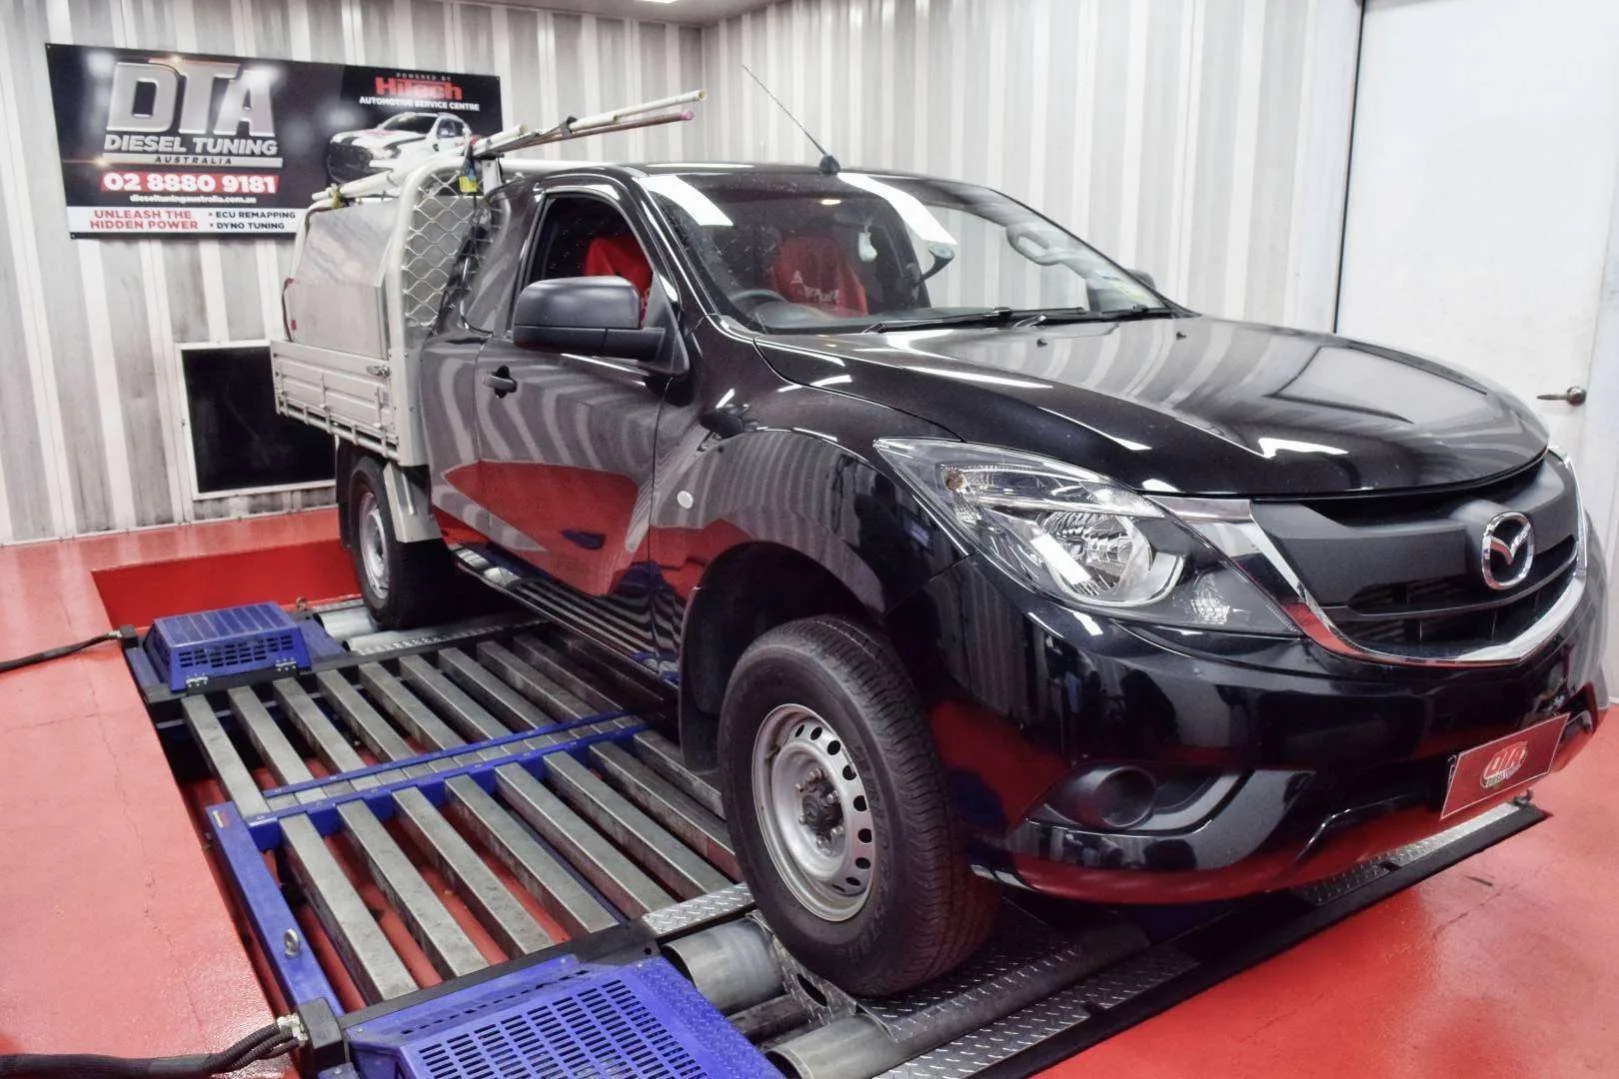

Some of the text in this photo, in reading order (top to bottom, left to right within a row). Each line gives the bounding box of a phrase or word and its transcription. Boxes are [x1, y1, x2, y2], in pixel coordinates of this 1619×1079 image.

[106, 58, 276, 137] DTA
[359, 96, 480, 111] AUTOMOTIVE SERVICE CENTRE
[104, 134, 278, 156] DIESEL TUNING
[155, 156, 232, 165] AUSTRALIA
[103, 172, 277, 194] 02 8880 9181
[94, 209, 192, 219] UNLEASH THE
[215, 211, 296, 219] ECU REMAPPING
[90, 220, 198, 230] HIDDEN POWER
[216, 221, 285, 230] DYNO TUNING
